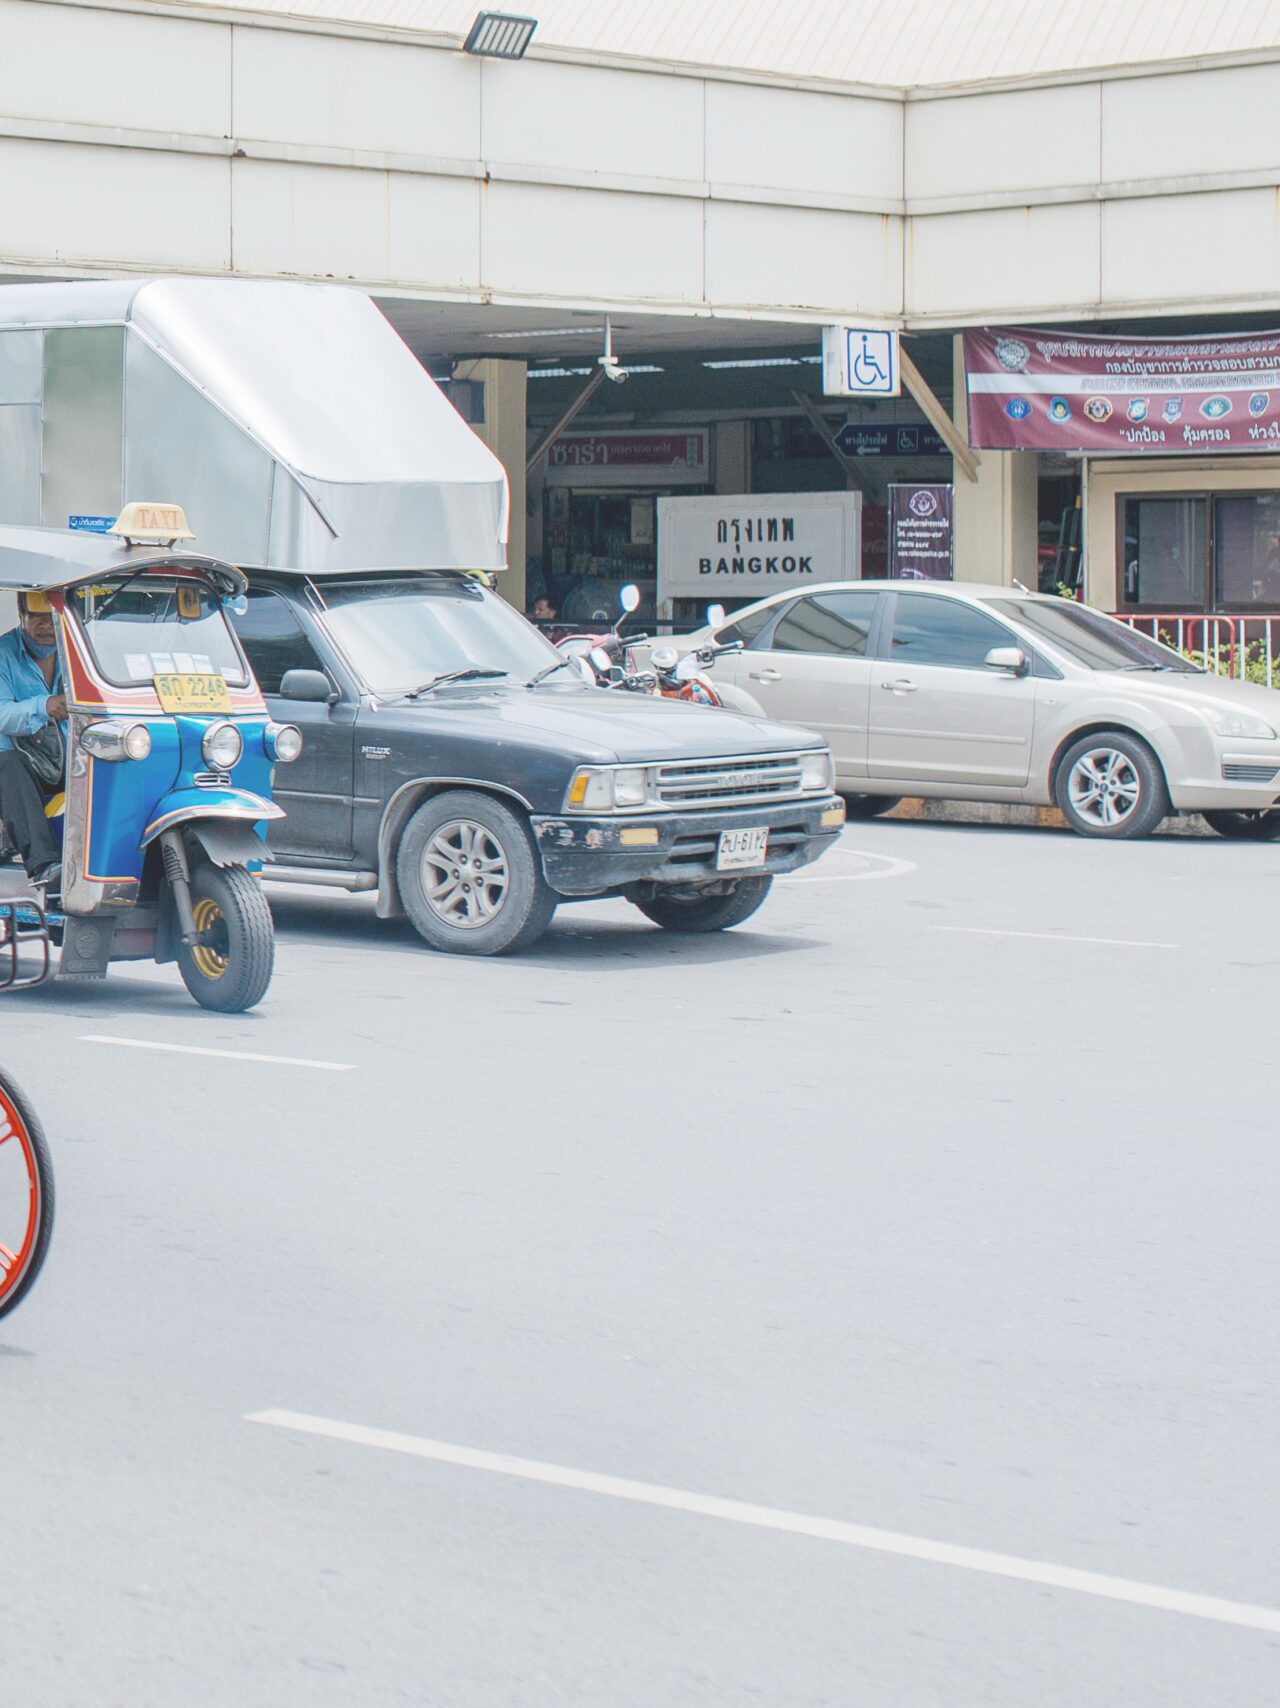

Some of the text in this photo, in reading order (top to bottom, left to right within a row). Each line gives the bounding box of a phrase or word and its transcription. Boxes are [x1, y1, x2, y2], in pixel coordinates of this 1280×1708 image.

[551, 438, 609, 465] ซาร่า
[138, 508, 180, 529] TAXI
[717, 517, 795, 554] กรุงเทพ
[699, 556, 813, 575] BANGKOK
[188, 676, 226, 697] 2246
[361, 745, 391, 755] HILUX
